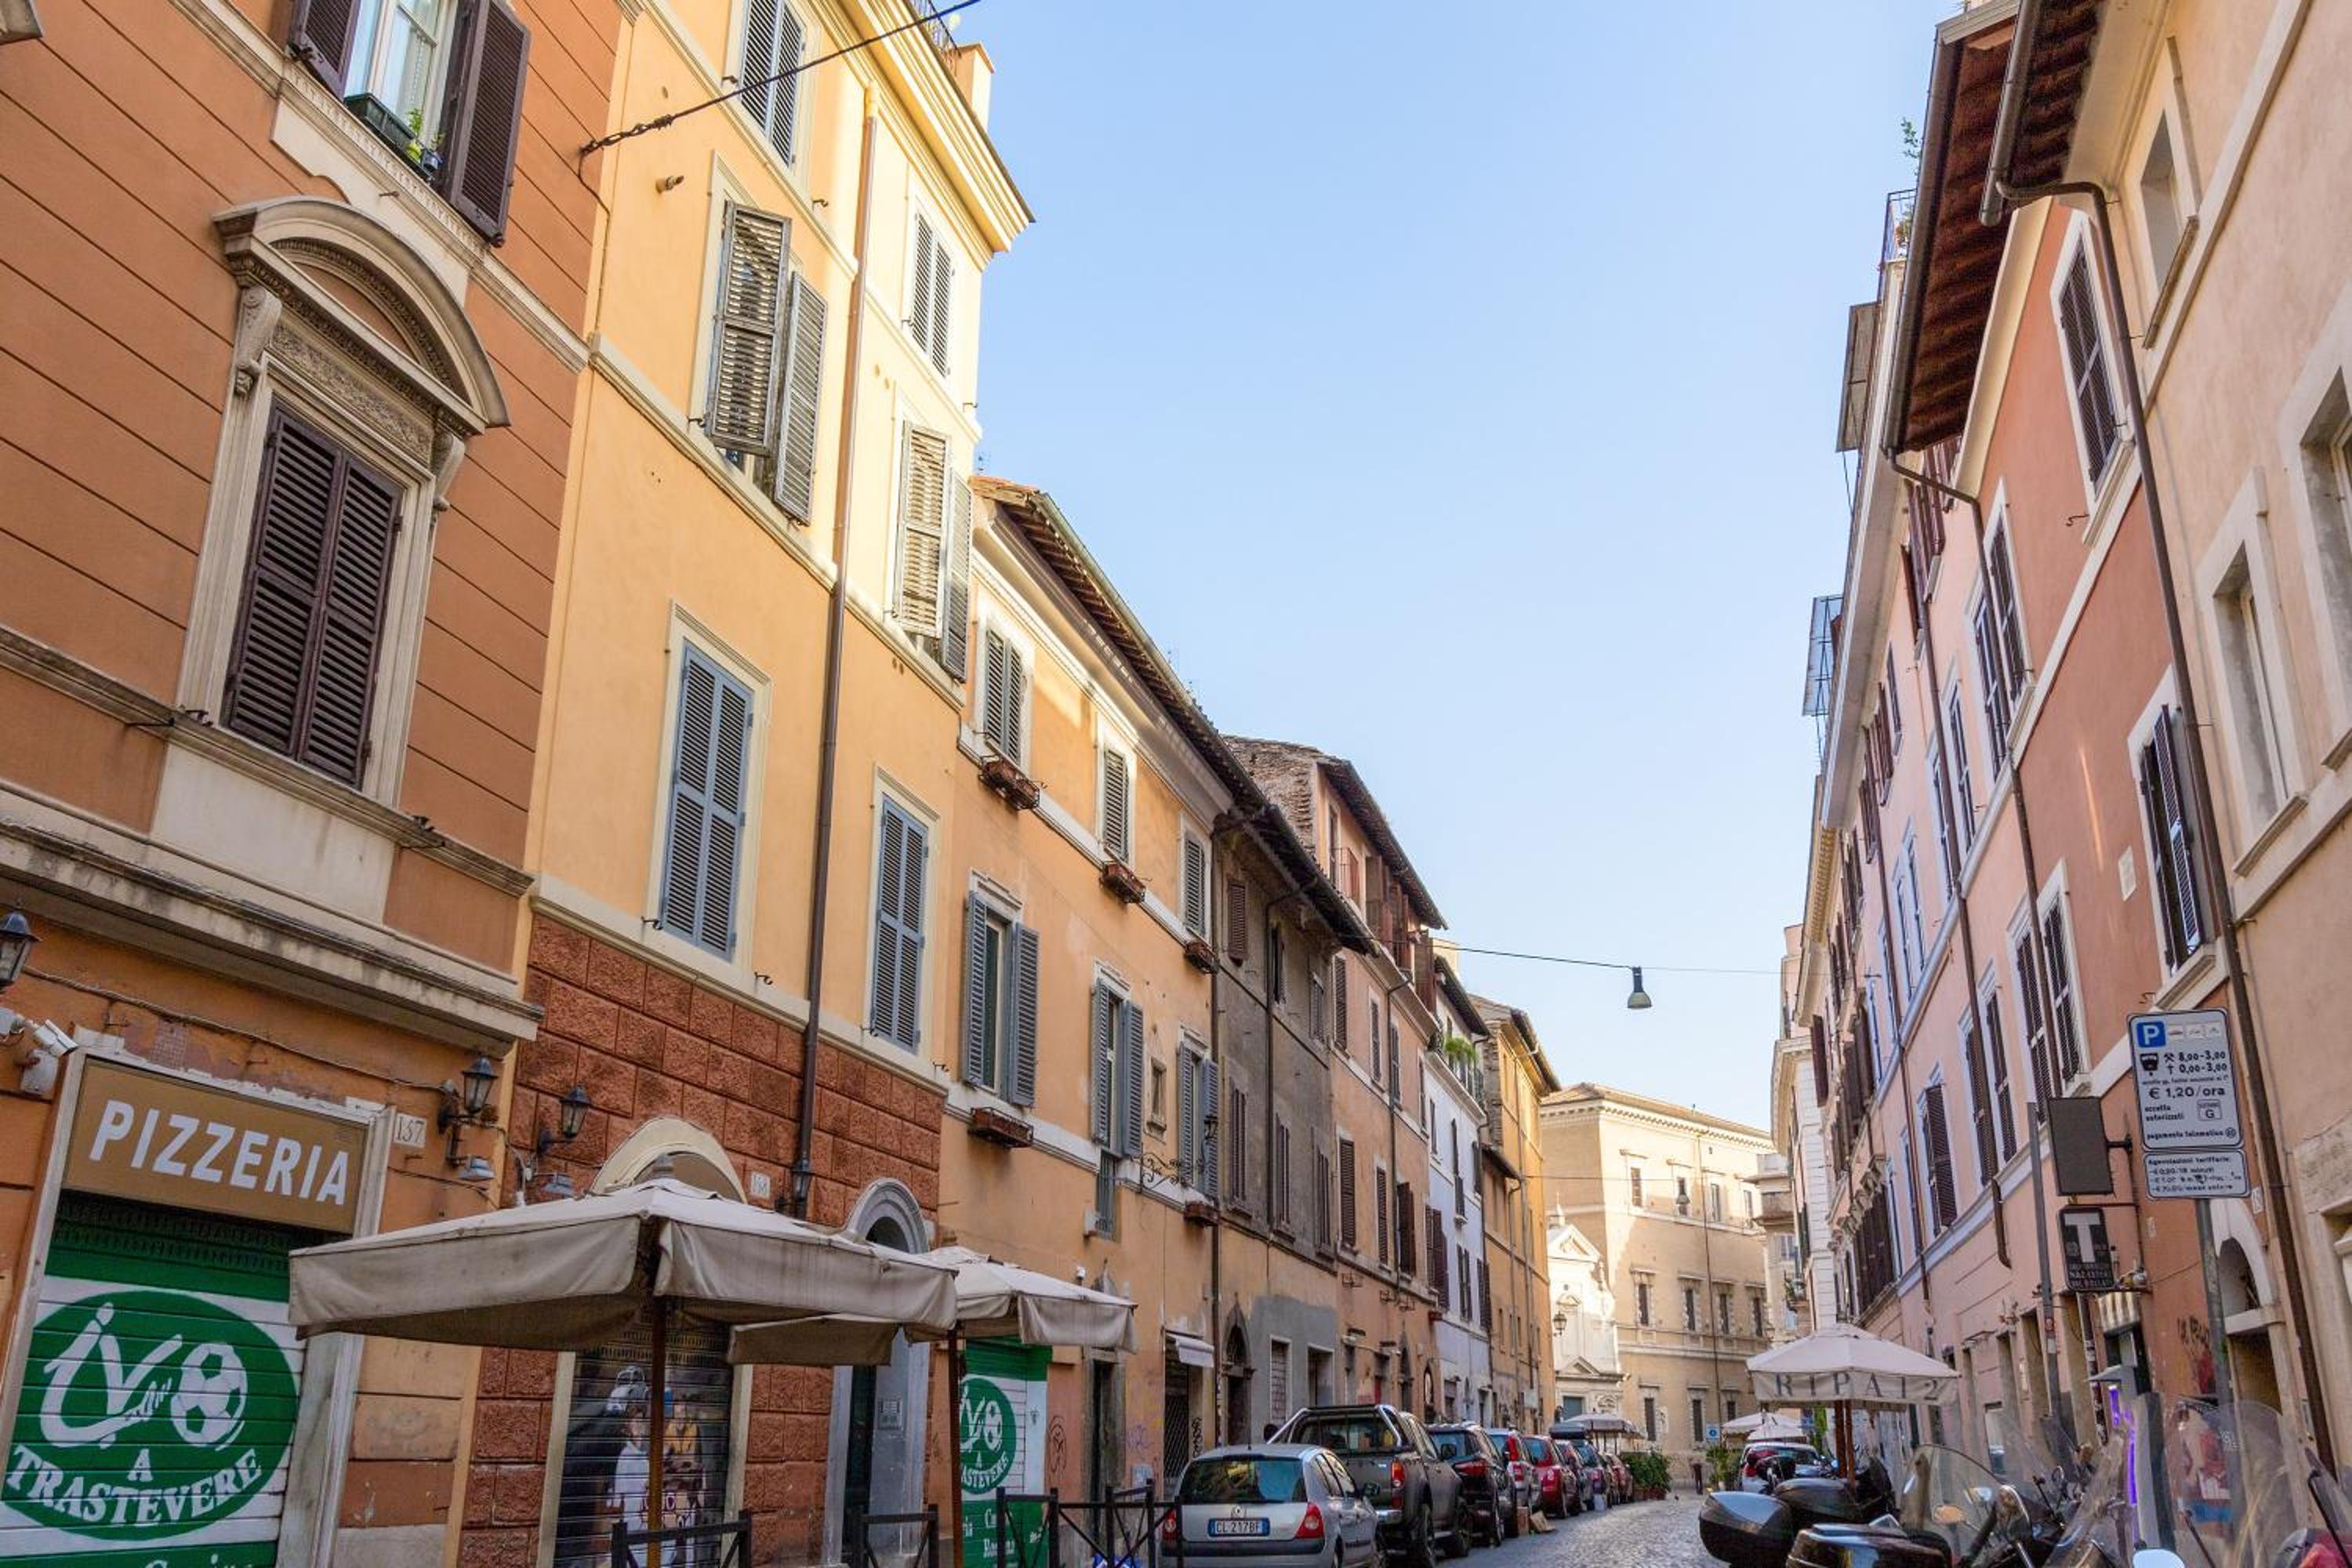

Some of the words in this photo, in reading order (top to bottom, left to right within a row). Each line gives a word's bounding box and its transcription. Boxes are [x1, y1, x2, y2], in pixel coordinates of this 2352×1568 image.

[2143, 1025, 2160, 1045] P
[2179, 1062, 2227, 1075] 0,00-3,00
[397, 1116, 425, 1142] 157
[2205, 1109, 2216, 1119] G
[89, 1098, 350, 1206] PIZZERIA
[2063, 1213, 2101, 1263] T
[128, 1449, 154, 1482] A
[961, 1450, 1010, 1488] ASTEVERE
[5, 1443, 263, 1527] TRASTEVERE
